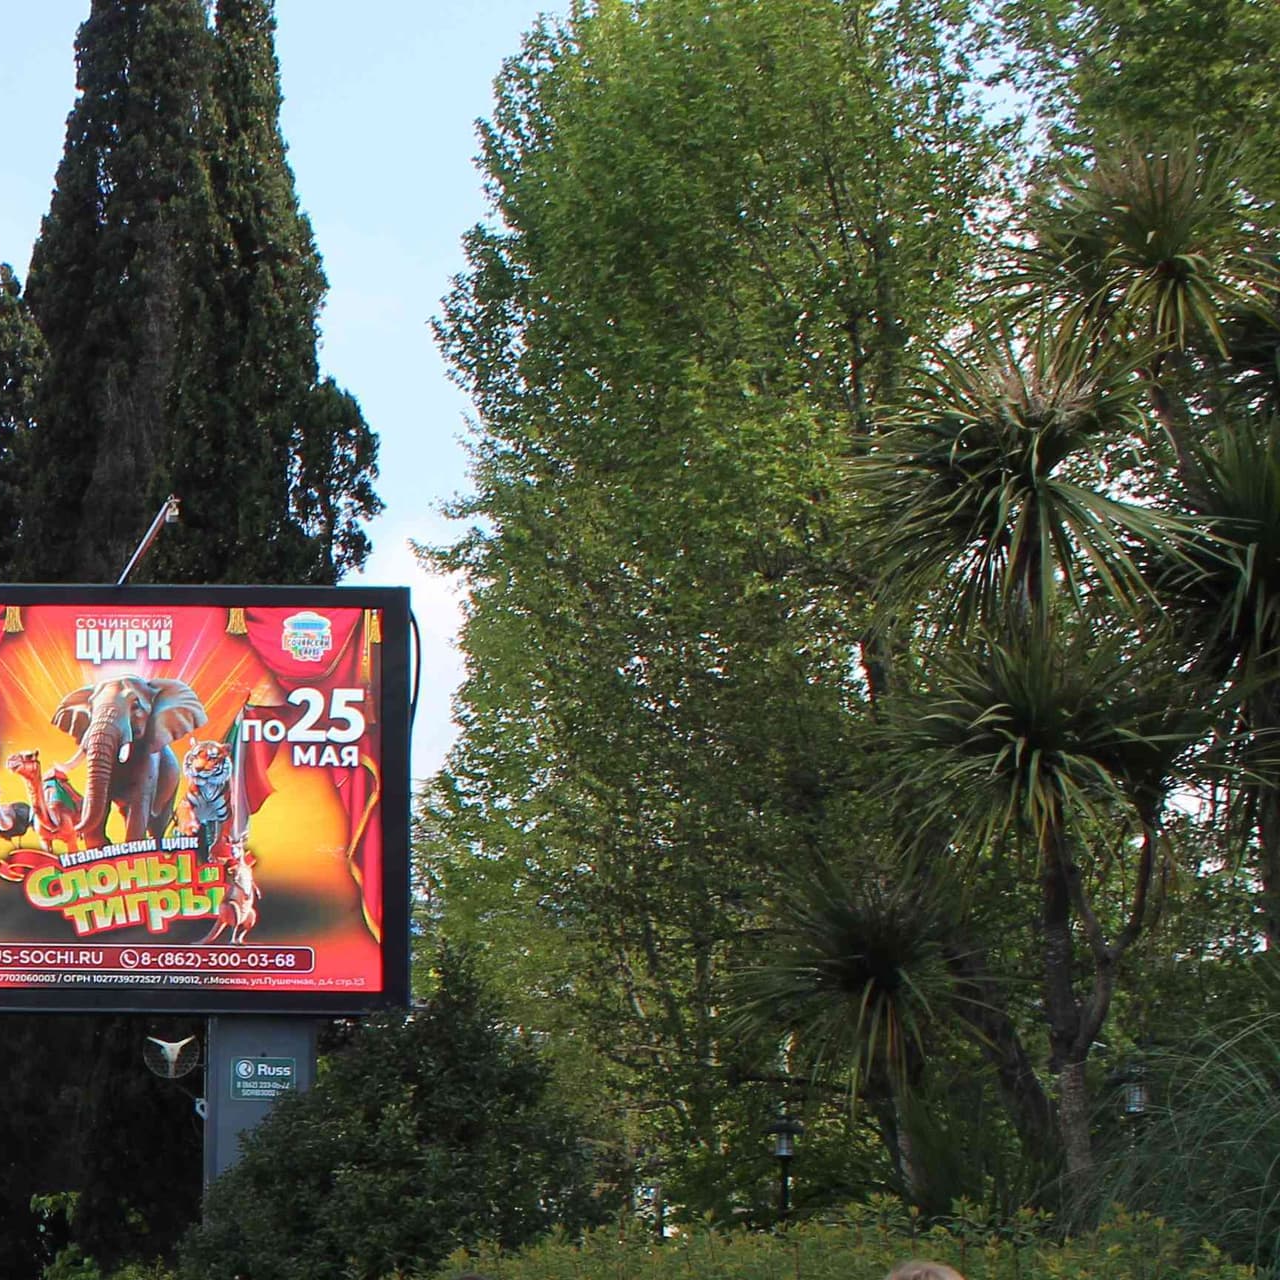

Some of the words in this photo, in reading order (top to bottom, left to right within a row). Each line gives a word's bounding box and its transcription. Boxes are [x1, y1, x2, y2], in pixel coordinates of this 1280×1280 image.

[76, 615, 173, 629] СОЧИНСКИЙ
[76, 629, 171, 664] ЦИРК
[287, 687, 365, 743] 25
[294, 746, 359, 767] МАЯ
[60, 839, 156, 868] Итальянский
[141, 952, 296, 968] 8-(862)-300-03-68
[64, 974, 90, 983] ОГРН
[257, 1063, 291, 1076] Russ
